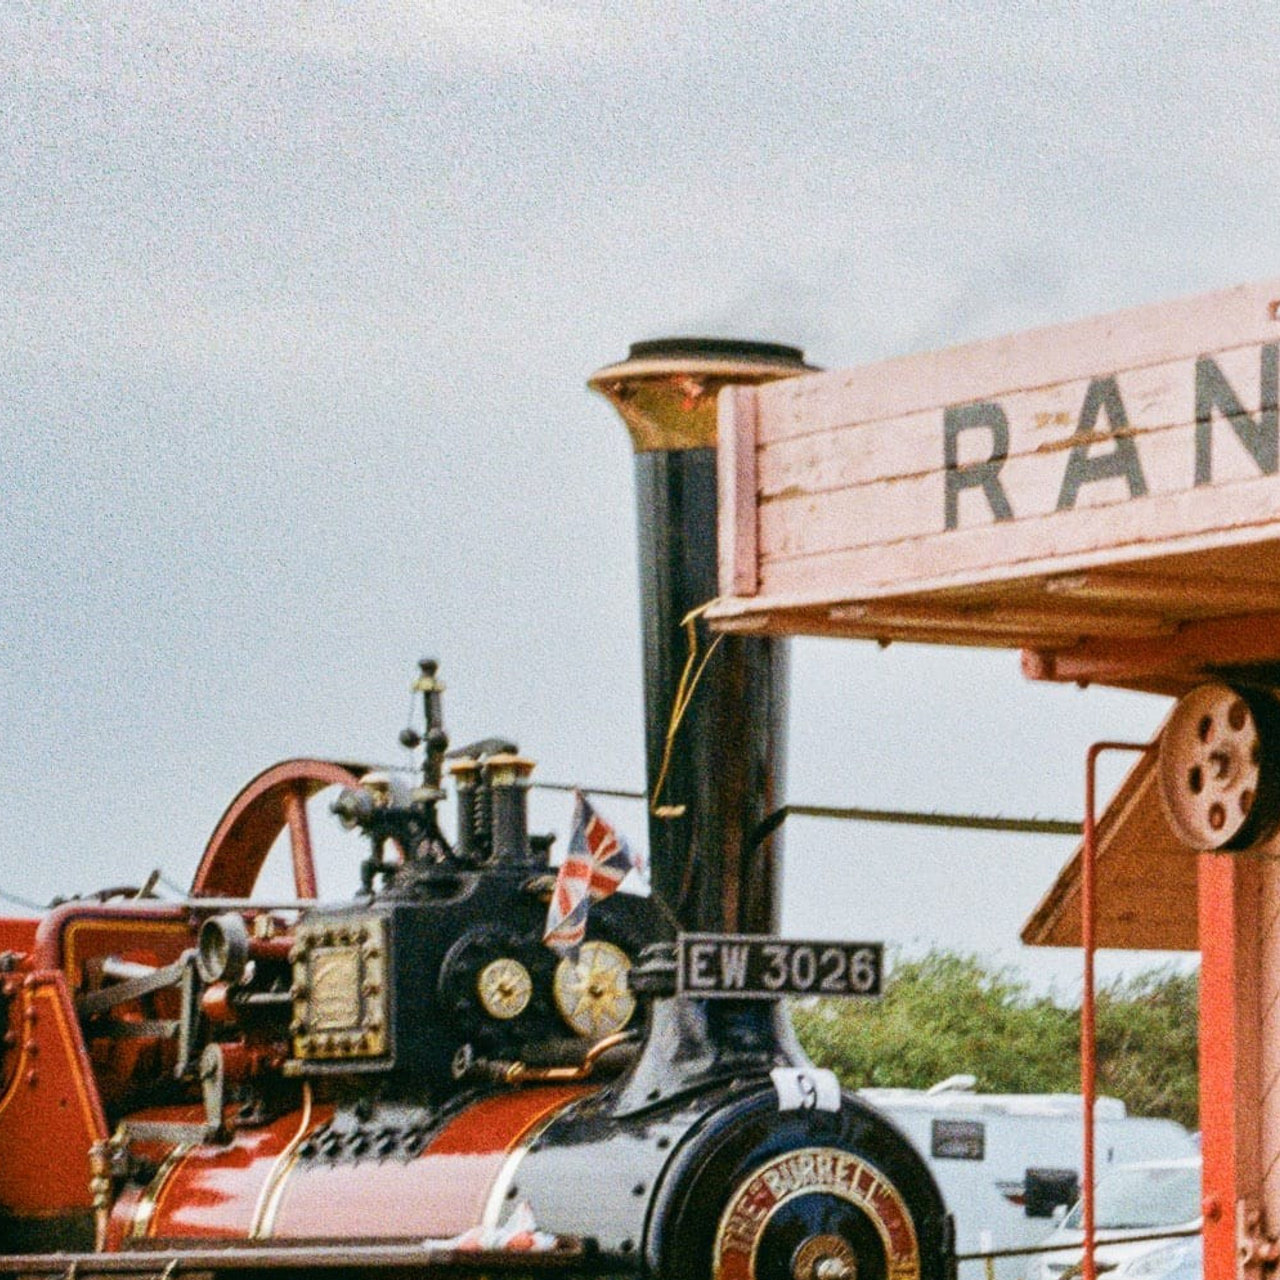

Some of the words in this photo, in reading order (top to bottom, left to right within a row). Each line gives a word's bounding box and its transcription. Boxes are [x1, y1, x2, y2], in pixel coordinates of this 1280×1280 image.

[690, 944, 749, 988] EW
[762, 945, 876, 991] 3026
[723, 1195, 768, 1253] THE
